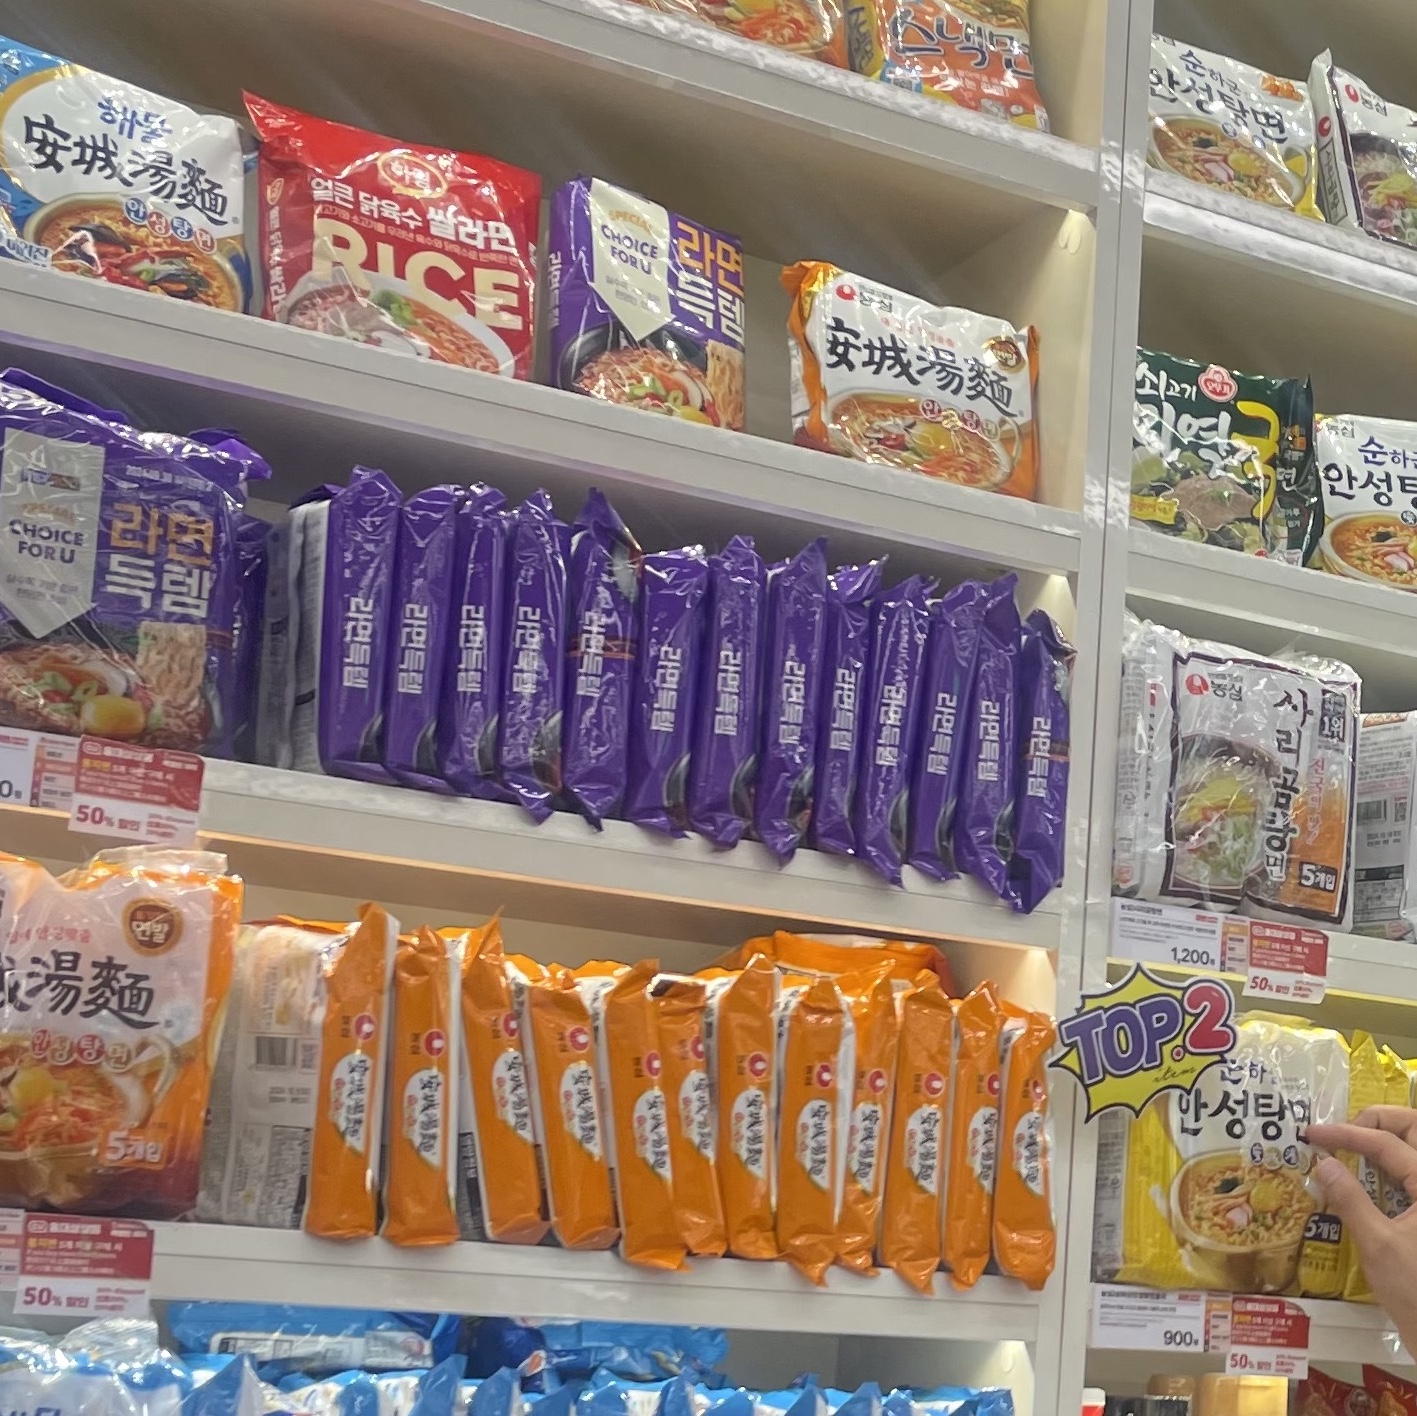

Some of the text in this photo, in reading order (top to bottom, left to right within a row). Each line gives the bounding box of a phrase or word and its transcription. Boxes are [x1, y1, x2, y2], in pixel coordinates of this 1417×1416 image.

[889, 8, 1037, 78] 스낵면
[22, 112, 231, 227] 安城湯麵
[310, 177, 355, 213] 얼큰
[357, 190, 425, 224] 닭육수
[425, 205, 519, 259] 쌀라면
[601, 223, 660, 261] CHOICE
[610, 244, 653, 277] FOR U
[677, 220, 745, 294] 라면
[312, 218, 525, 332] RICE
[675, 270, 746, 348] 득템
[825, 317, 1018, 418] 安城湯麵
[1136, 361, 1197, 402] 쇠고기
[9, 520, 85, 547] CHOICE
[18, 540, 76, 565] FOR U
[109, 502, 215, 567] 라면
[105, 554, 215, 619] 득템
[1301, 864, 1335, 891] 5개입
[1249, 974, 1274, 992] 50%
[31, 1030, 132, 1071] 안성탕면
[1178, 1091, 1312, 1145] 안성탕면
[105, 1131, 163, 1165] 5개입
[1305, 1216, 1341, 1241] 5개입
[23, 1286, 62, 1307] 50%
[1229, 1353, 1255, 1370] 50%
